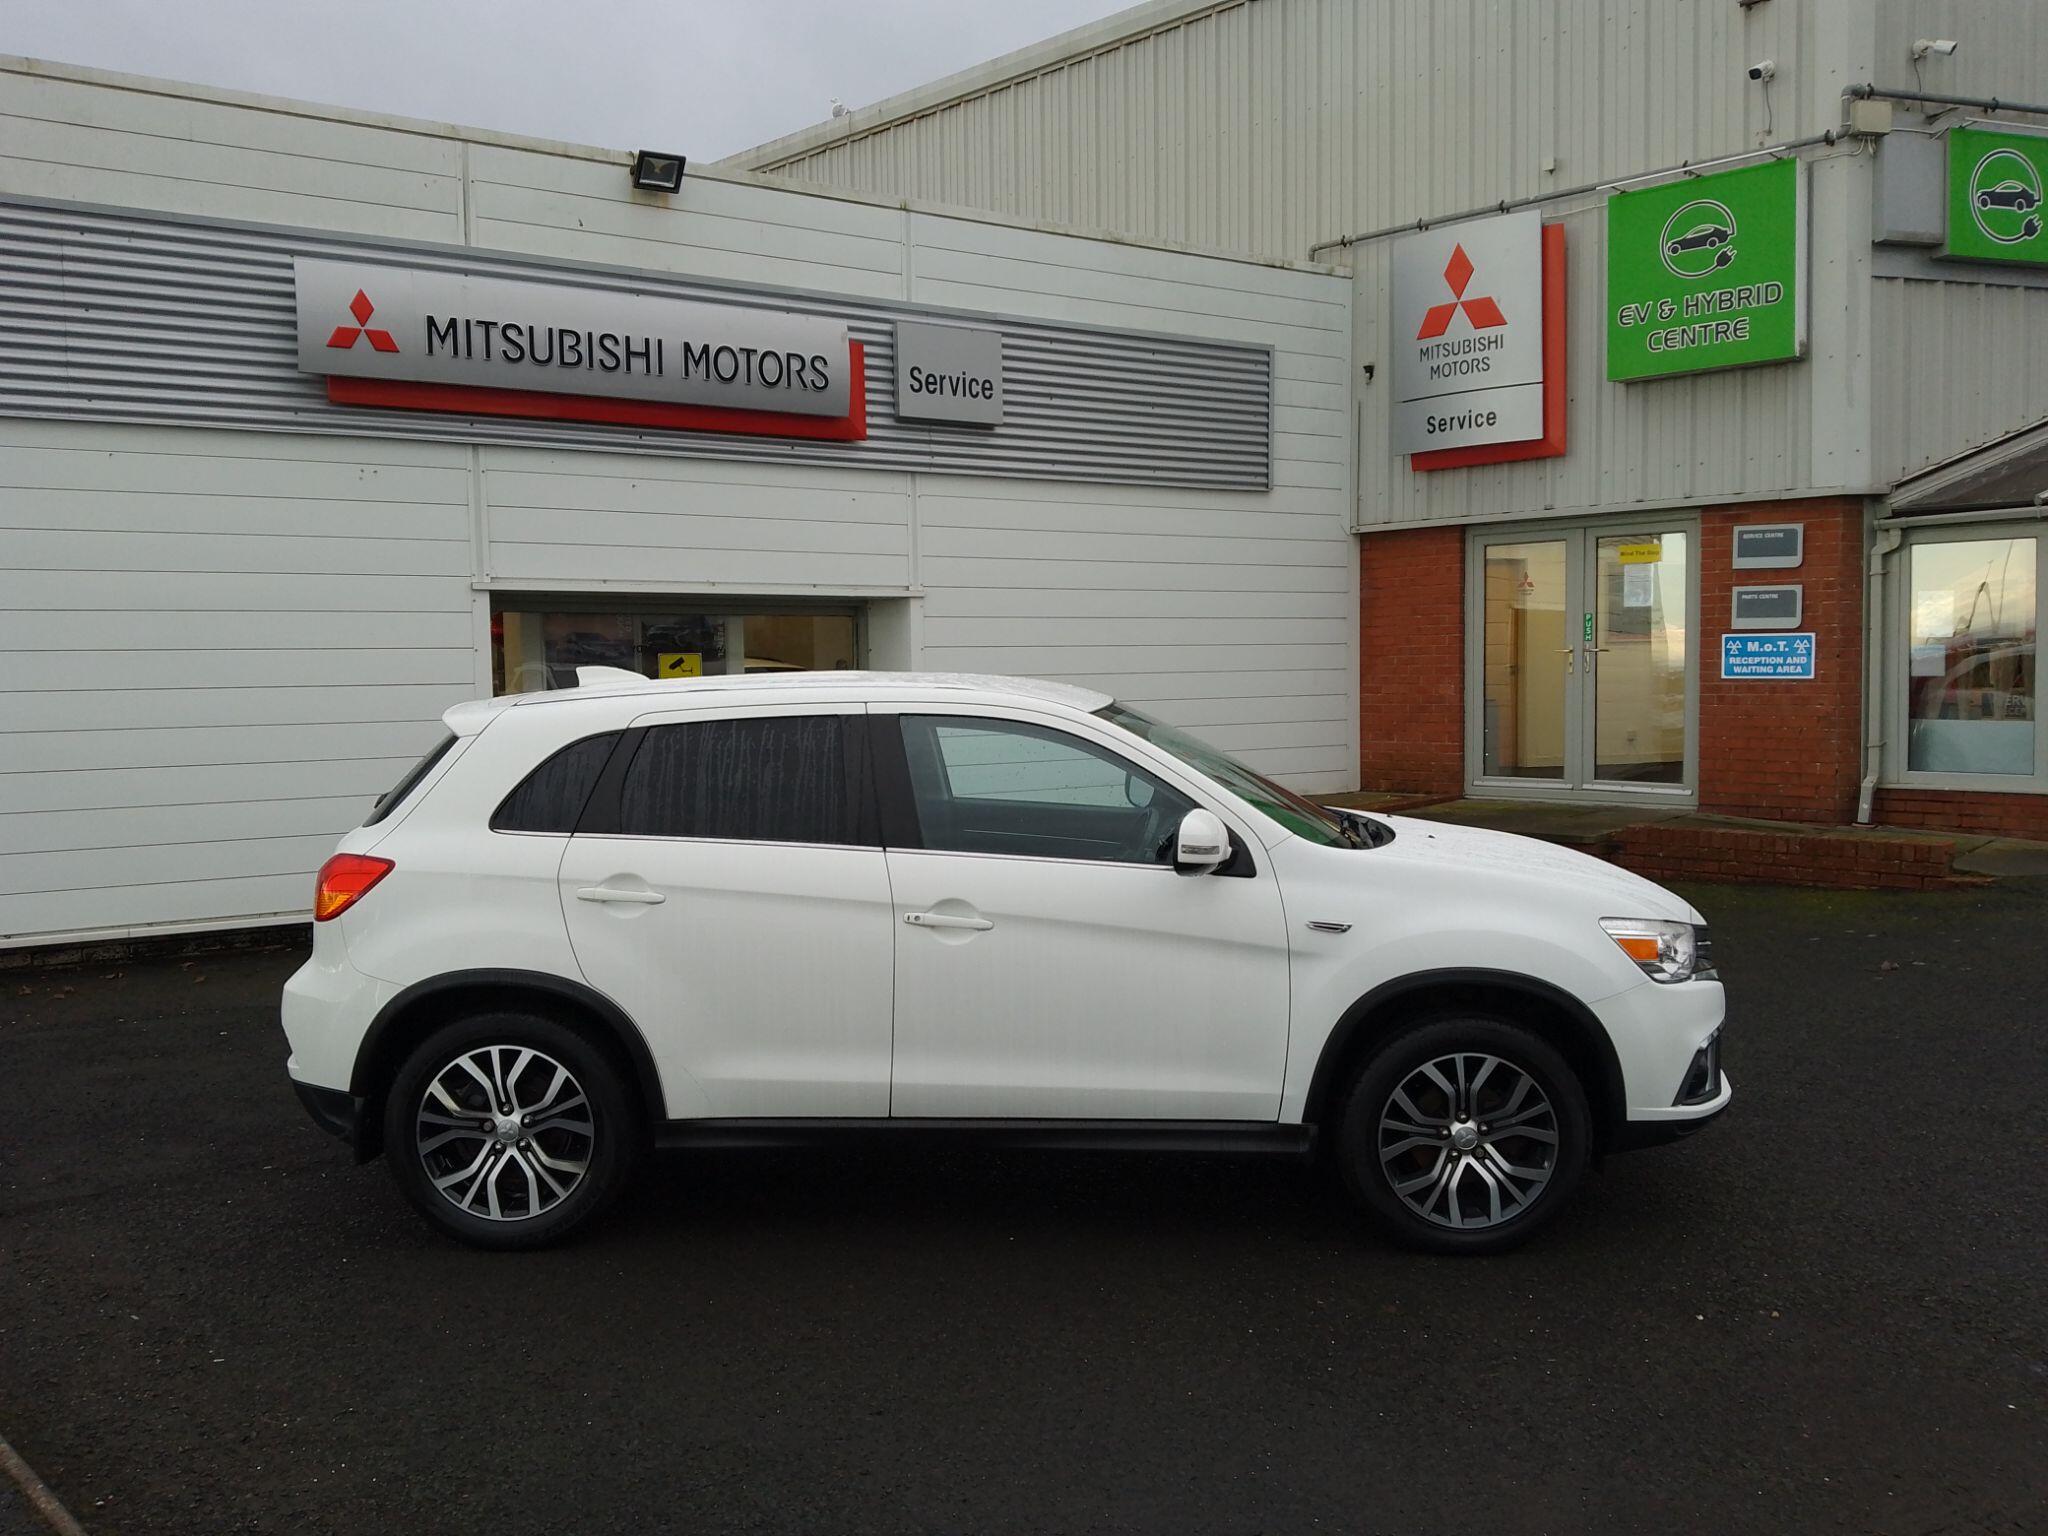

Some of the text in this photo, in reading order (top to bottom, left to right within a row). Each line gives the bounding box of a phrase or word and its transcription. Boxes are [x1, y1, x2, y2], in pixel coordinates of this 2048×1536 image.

[1618, 281, 1783, 327] EV & HYBRID
[1419, 333, 1505, 363] MITSUBISHI
[1647, 316, 1750, 353] CENTRE
[425, 313, 831, 392] MITSUBISHI MOTORS
[1429, 356, 1492, 381] MOTORS
[909, 366, 994, 400] Service
[1426, 409, 1498, 435] Service
[1729, 656, 1808, 664] RECEPTION AND
[1747, 641, 1790, 652] M.o.T.
[1733, 665, 1803, 673] WAITING AREA
